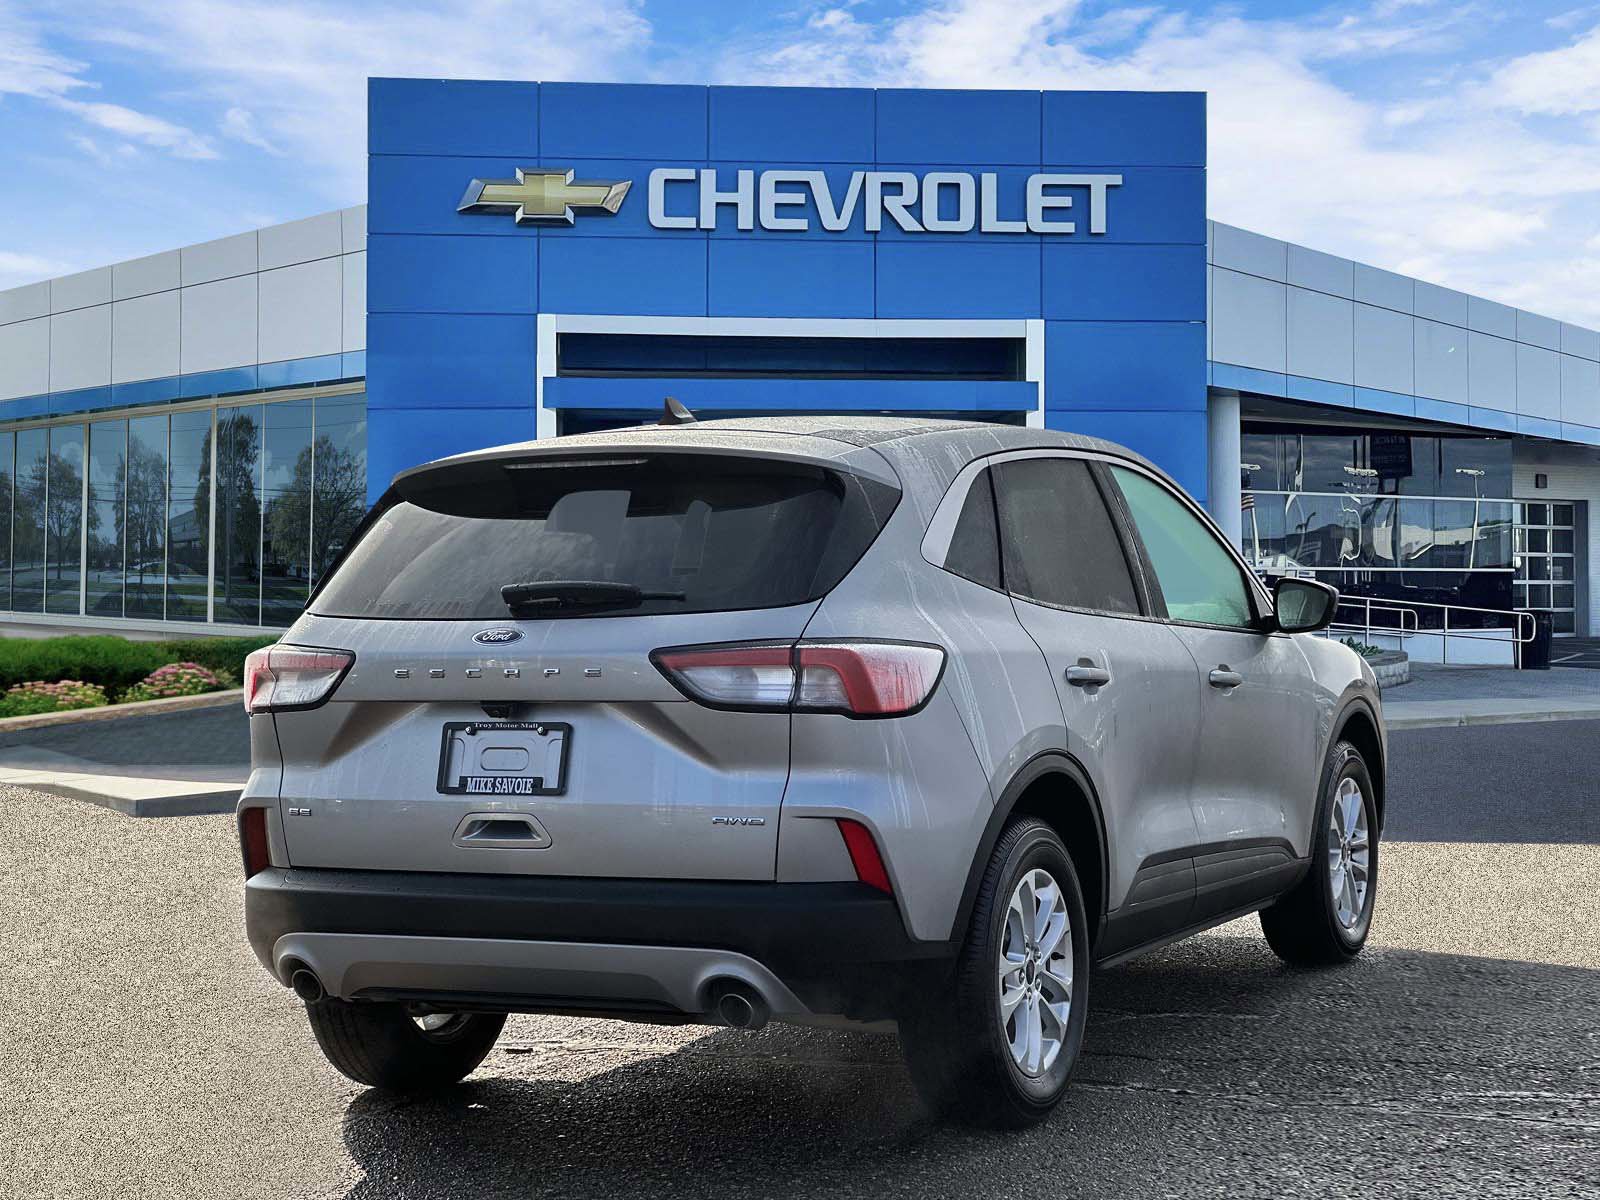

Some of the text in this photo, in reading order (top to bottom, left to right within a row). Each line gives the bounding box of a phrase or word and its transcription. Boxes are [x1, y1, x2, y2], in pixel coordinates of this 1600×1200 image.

[648, 168, 1123, 234] CHEVROLET
[481, 629, 513, 642] Ford
[394, 668, 602, 679] ESCAPE
[466, 777, 534, 794] MIKE SAVOIE
[289, 807, 312, 816] SE
[712, 816, 766, 826] AWD
